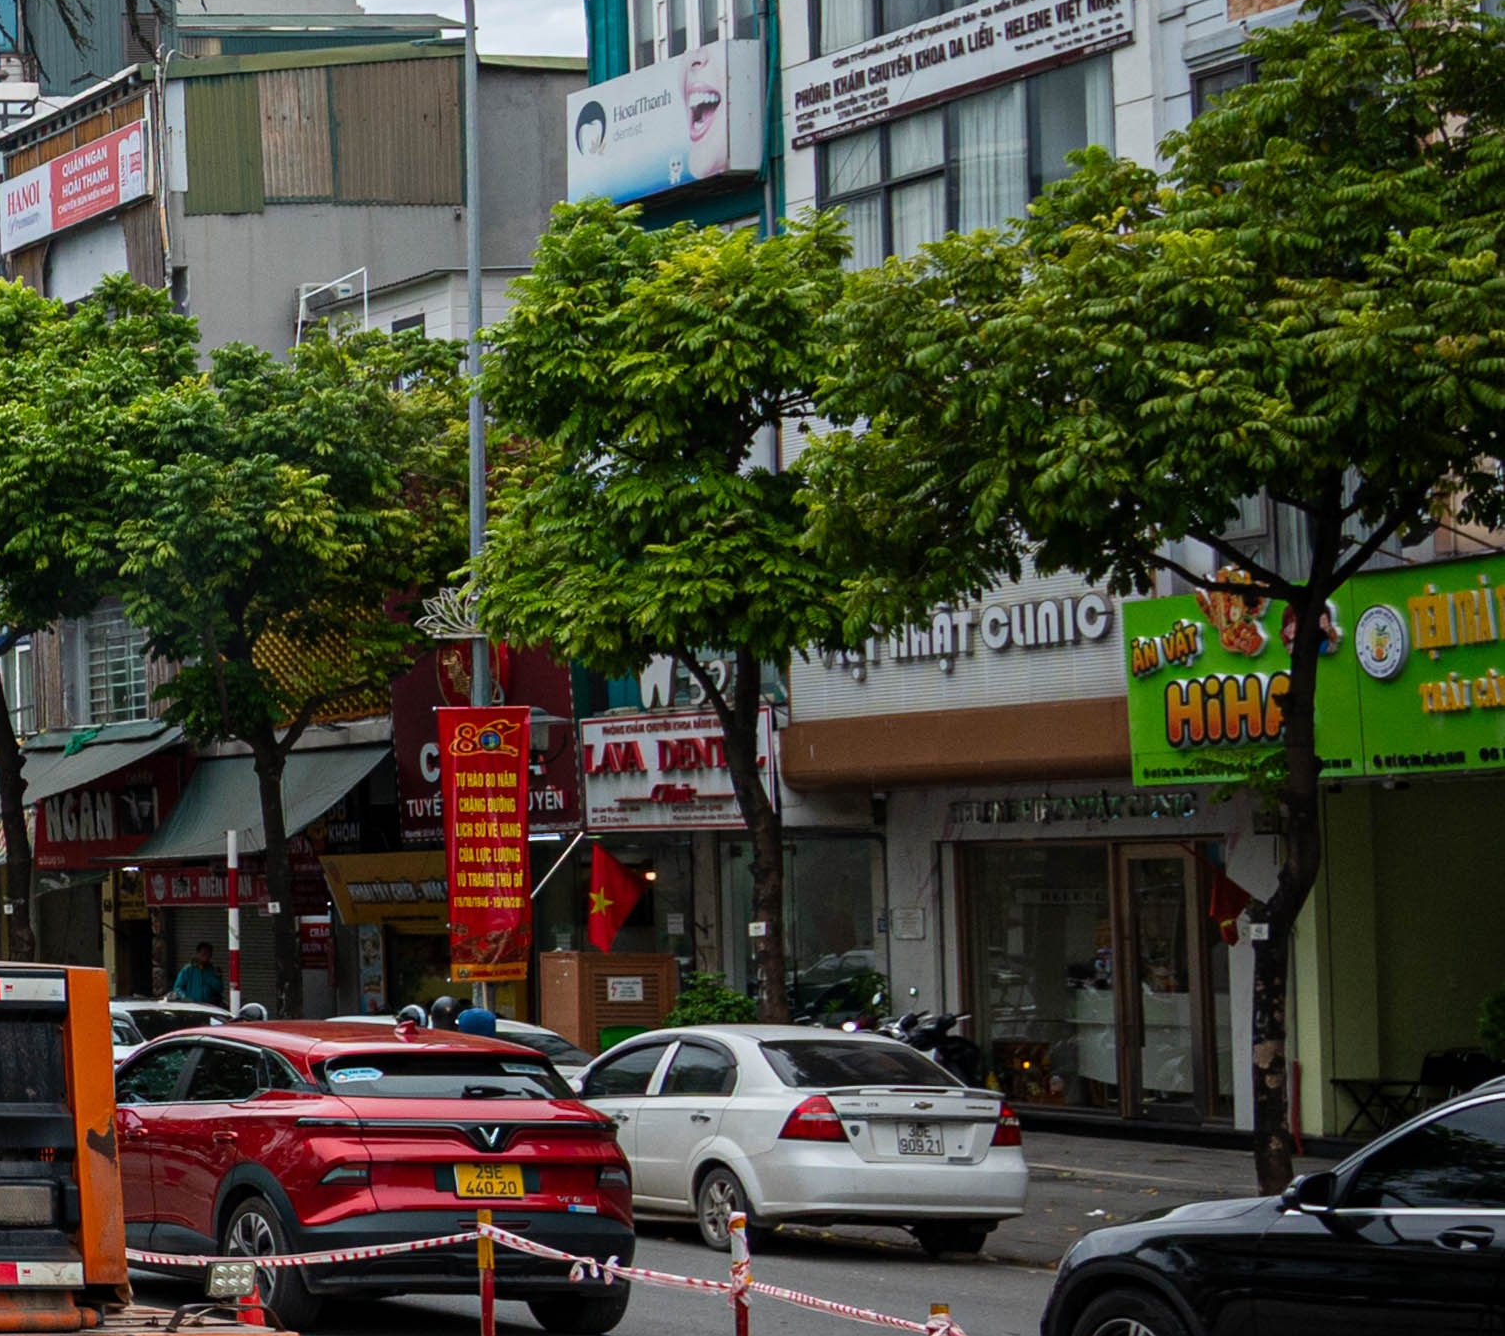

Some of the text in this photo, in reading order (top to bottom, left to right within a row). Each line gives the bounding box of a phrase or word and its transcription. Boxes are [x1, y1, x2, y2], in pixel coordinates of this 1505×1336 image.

[795, 82, 830, 109] PHÒNG
[834, 69, 865, 97] KHÁM
[868, 53, 912, 85] CHUYÊN
[915, 44, 947, 71] KHOA
[948, 38, 965, 59] DA
[1004, 8, 1052, 41] HELENE
[84, 145, 108, 169] NGAN
[83, 166, 109, 189] THANH
[7, 180, 41, 217] HANOI
[981, 592, 1115, 651] CLINIC
[1131, 620, 1199, 677] ĂN VẬT
[1473, 667, 1505, 710] CÂ
[584, 740, 647, 774] LAVA
[467, 770, 484, 787] HÀO
[45, 791, 114, 842] NGAN
[406, 792, 444, 818] TUYẾ
[465, 1181, 518, 1196] 440.20
[475, 1165, 503, 1180] 29E
